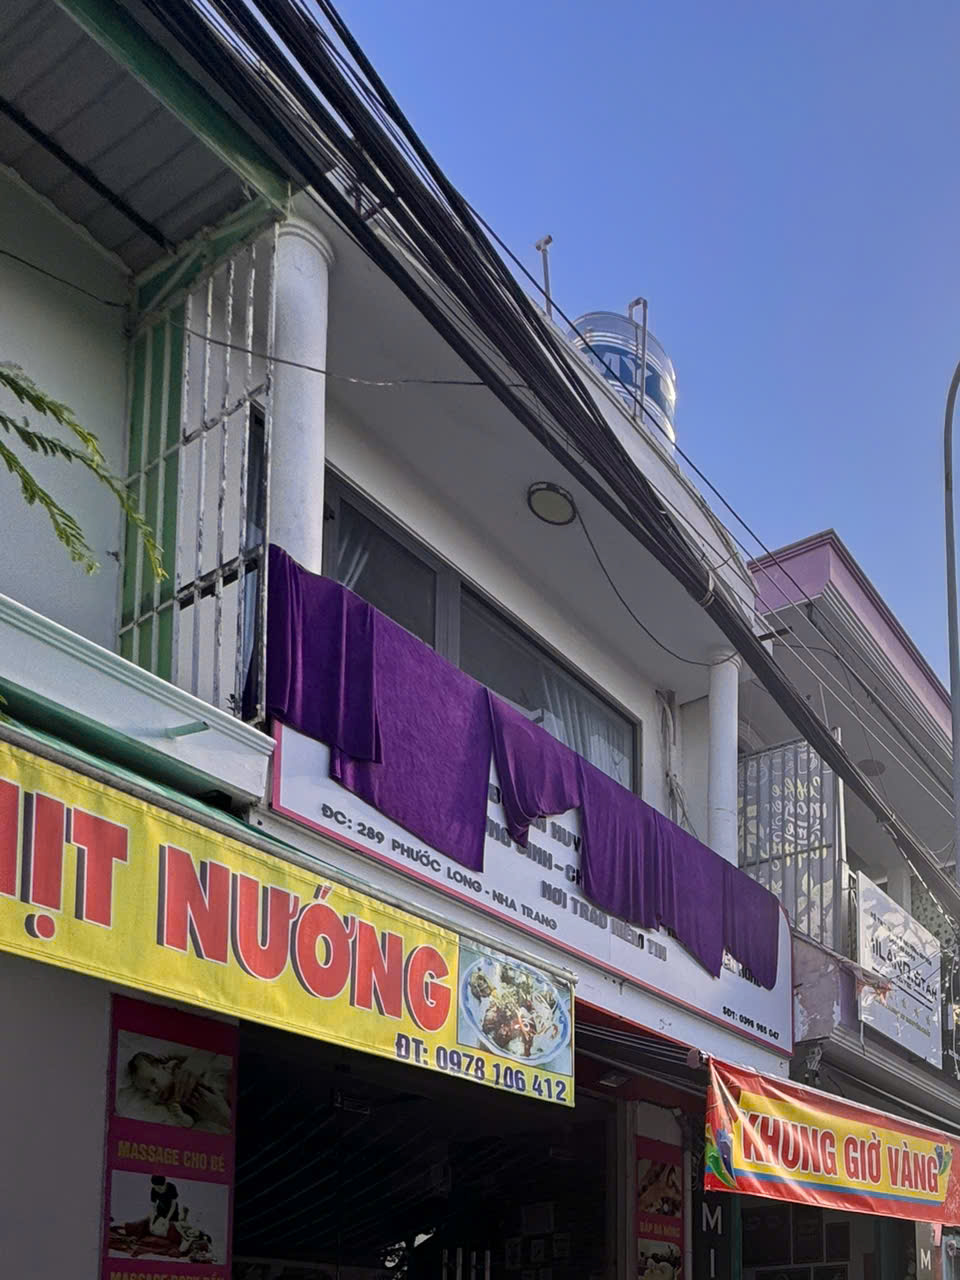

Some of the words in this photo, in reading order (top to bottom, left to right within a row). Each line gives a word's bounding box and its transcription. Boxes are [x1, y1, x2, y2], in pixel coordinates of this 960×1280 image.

[321, 803, 352, 829] ĐC:
[356, 822, 385, 844] 289
[392, 838, 441, 873] PHƯỚC
[447, 866, 482, 893] LONG
[492, 889, 517, 912] NHA
[521, 903, 558, 930] TRANG
[160, 844, 452, 1032] NƯỚNG
[395, 1032, 429, 1065] ĐT:
[436, 1046, 486, 1081] 0978
[493, 1063, 526, 1092] 106
[533, 1075, 567, 1101] 412
[118, 1140, 179, 1166] MASSAGE
[183, 1150, 207, 1169] CHO
[741, 1111, 838, 1177] KHUNG
[844, 1131, 882, 1185] GIỜ
[887, 1141, 940, 1194] VÀNG
